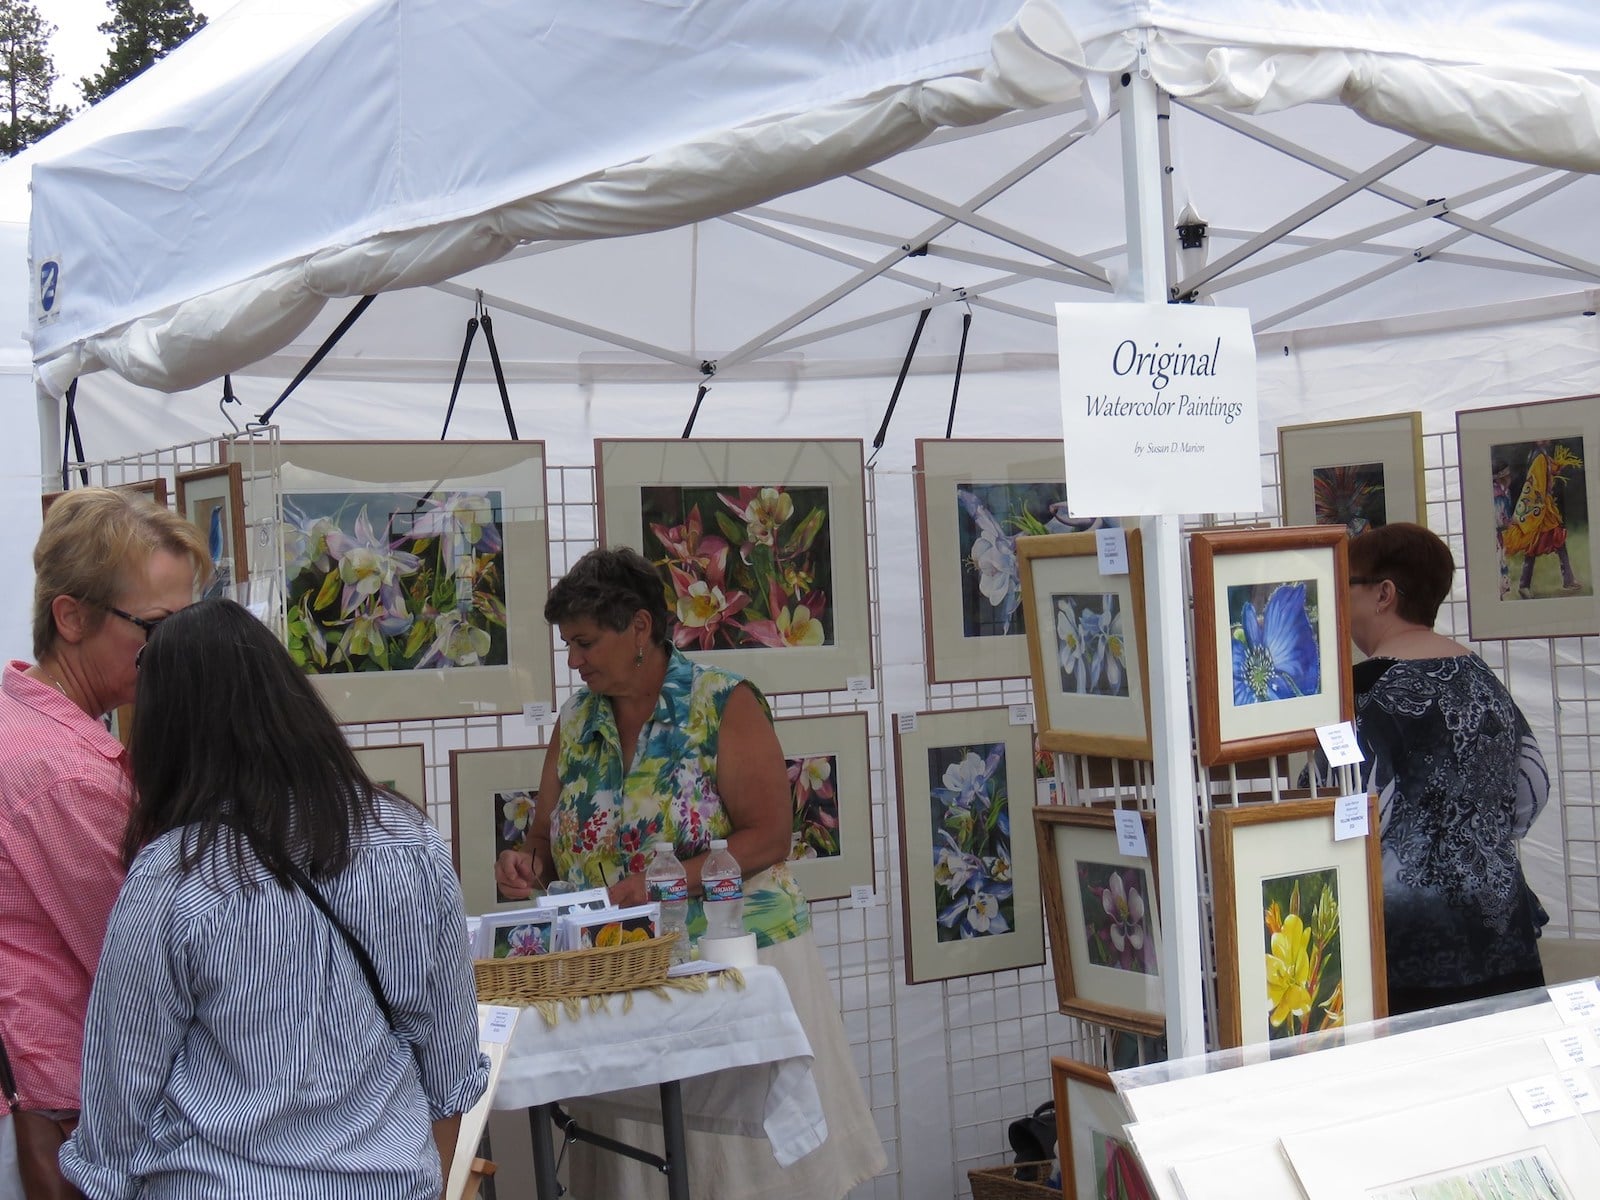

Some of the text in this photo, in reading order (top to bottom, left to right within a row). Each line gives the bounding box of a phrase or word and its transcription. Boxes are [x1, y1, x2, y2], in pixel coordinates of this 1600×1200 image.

[1112, 336, 1221, 390] Original
[1086, 391, 1243, 425] Watercolor Paintings
[1134, 441, 1144, 457] by
[1146, 441, 1169, 454] Susan
[1180, 442, 1205, 454] Marion
